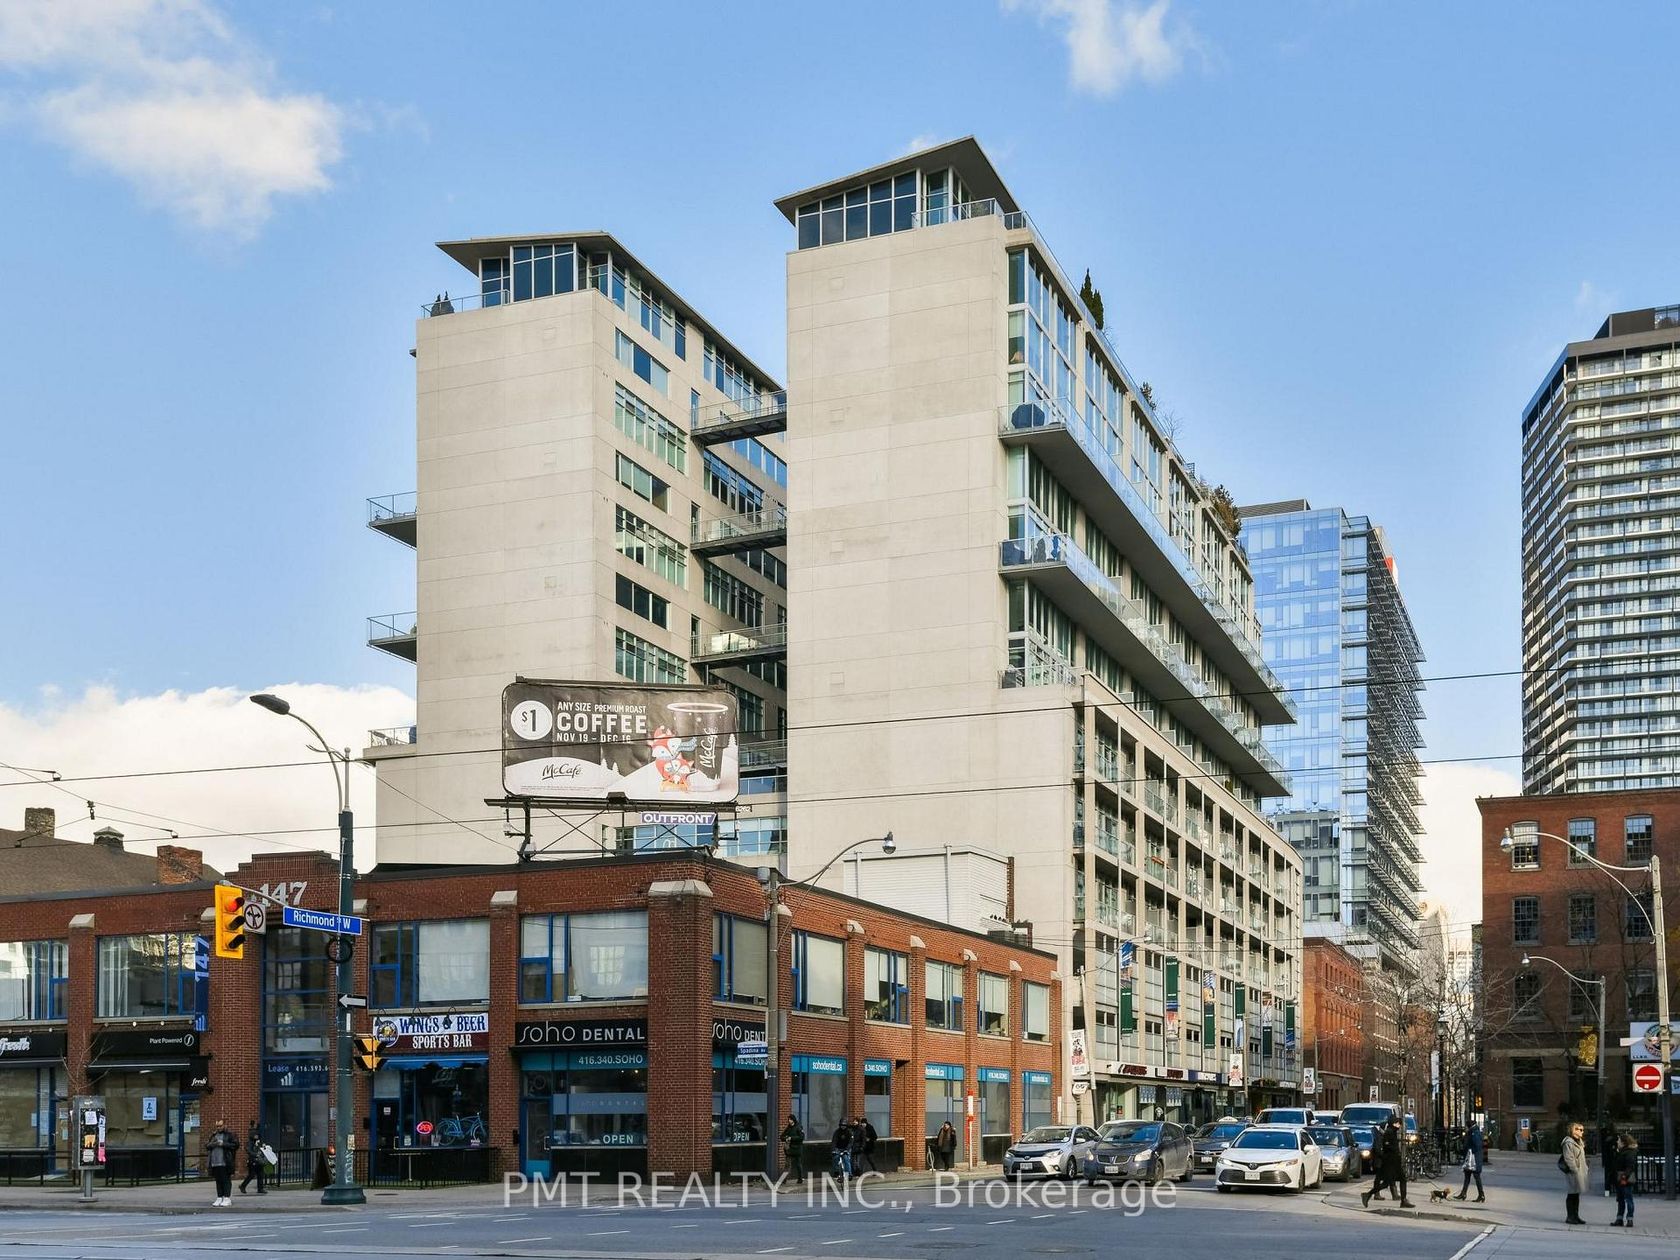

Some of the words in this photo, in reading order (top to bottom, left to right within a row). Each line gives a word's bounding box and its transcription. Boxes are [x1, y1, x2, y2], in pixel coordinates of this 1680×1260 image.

[557, 701, 573, 711] ANY
[574, 702, 591, 712] SIZE
[594, 704, 625, 713] PREMIUM
[625, 705, 647, 713] ROAST
[521, 709, 537, 732] $1
[556, 712, 647, 734] COFFEE
[556, 733, 575, 743] NOV
[578, 733, 589, 743] 19
[541, 763, 582, 781] McCafé
[643, 813, 712, 824] OUTFRONT
[259, 880, 308, 907] 147
[293, 910, 335, 927] Richmond
[343, 918, 351, 929] W
[195, 935, 210, 983] 147
[399, 1016, 440, 1034] WINGS
[456, 1015, 486, 1032] BEER
[519, 1020, 576, 1043] soho
[582, 1027, 645, 1041] DENTAL
[711, 1018, 742, 1041] soho
[412, 1035, 450, 1049] SPORTS
[452, 1033, 473, 1048] BAR
[268, 1064, 290, 1073] Lease
[578, 1054, 643, 1065] 416.340.SOHO
[602, 1134, 634, 1144] OPEN
[733, 1132, 750, 1142] OPEN
